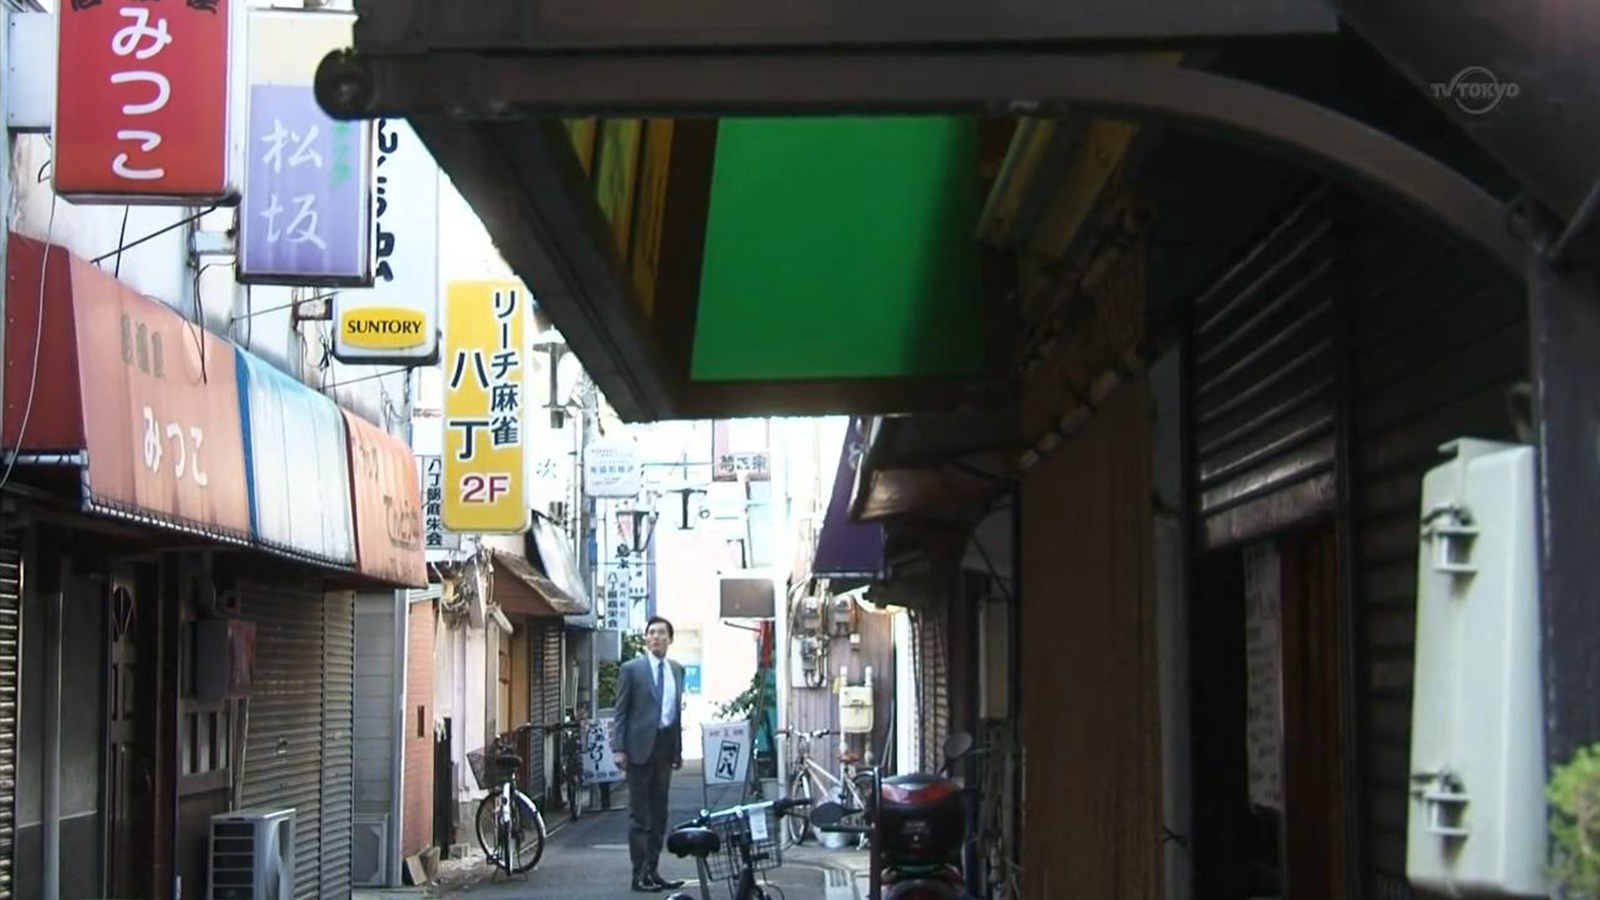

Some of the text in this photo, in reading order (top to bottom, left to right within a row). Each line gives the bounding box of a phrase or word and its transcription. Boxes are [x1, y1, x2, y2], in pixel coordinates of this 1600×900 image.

[111, 7, 172, 180] みつこ
[260, 118, 327, 250] 松坂
[346, 319, 422, 334] SUNTORY
[491, 291, 518, 446] リーチ麻雀
[143, 406, 208, 487] みつこ
[451, 352, 489, 460] 八丁
[462, 476, 508, 503] 2F
